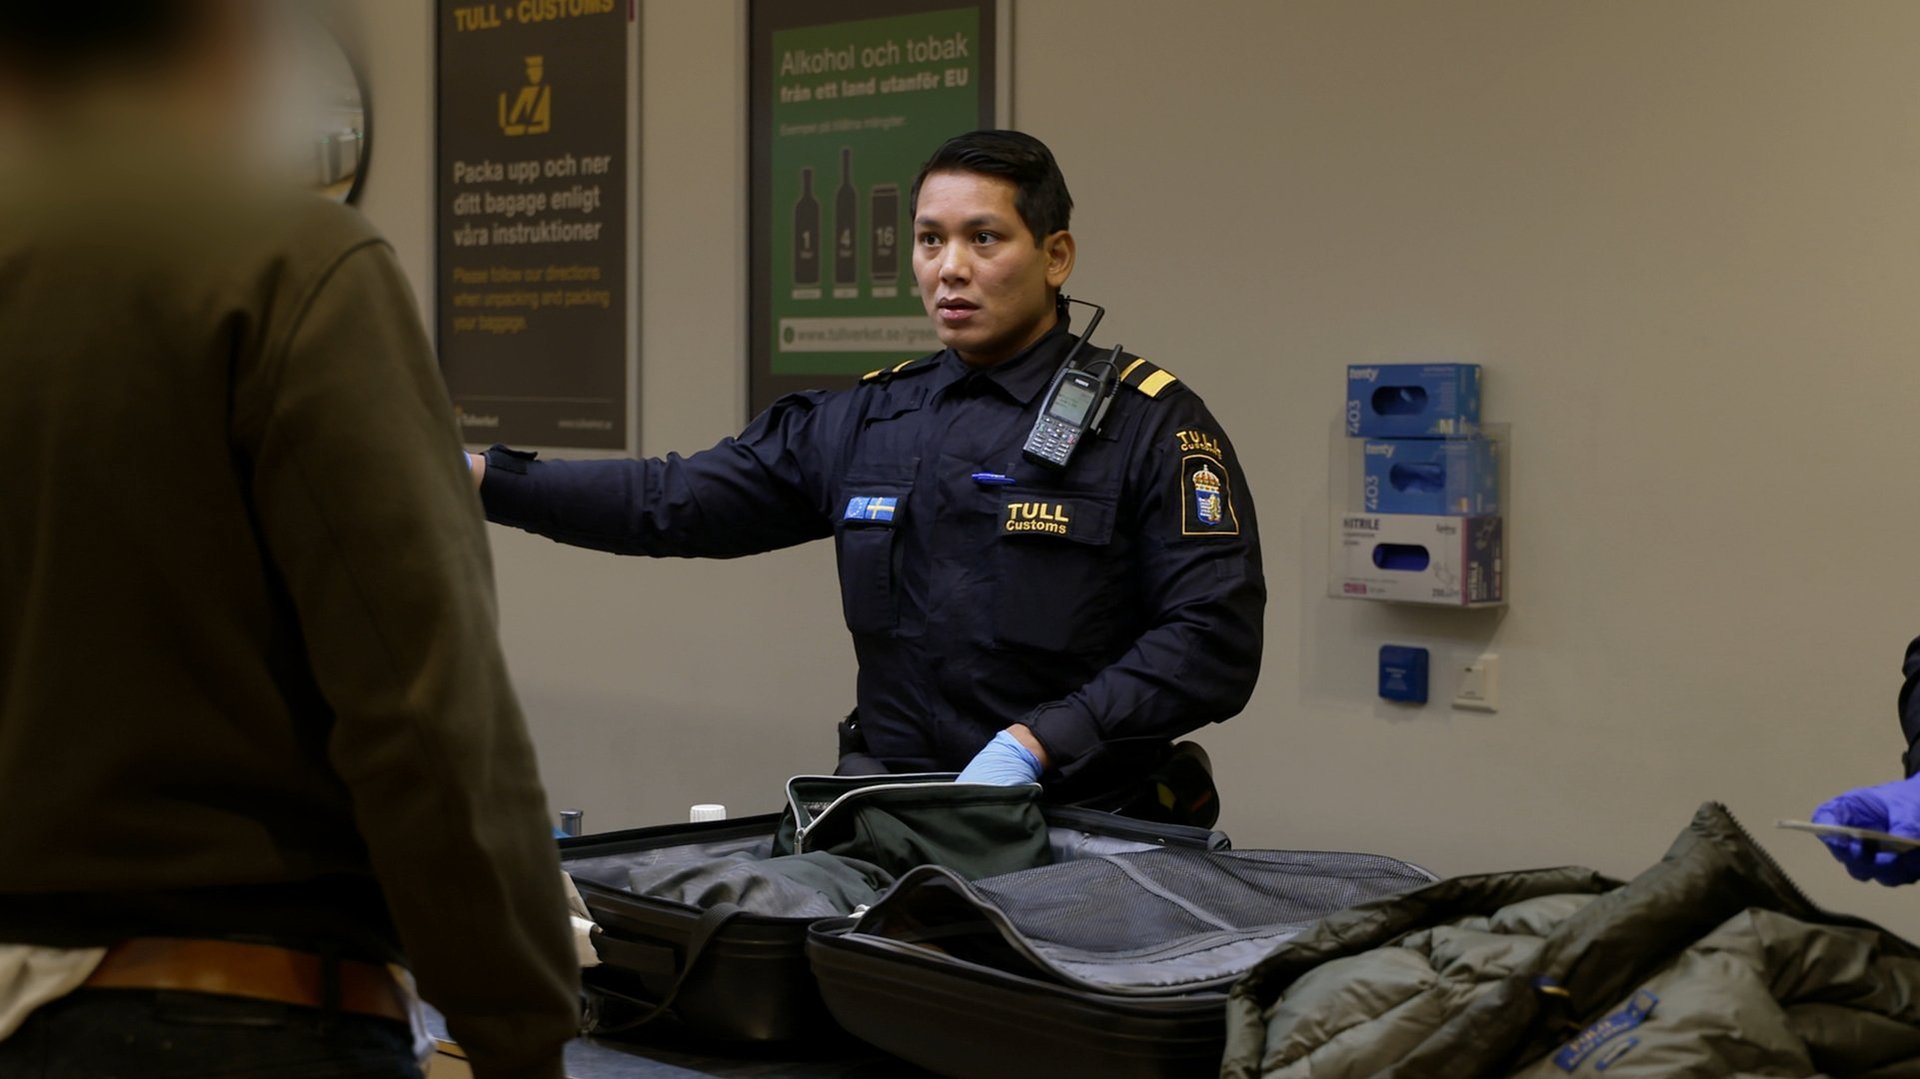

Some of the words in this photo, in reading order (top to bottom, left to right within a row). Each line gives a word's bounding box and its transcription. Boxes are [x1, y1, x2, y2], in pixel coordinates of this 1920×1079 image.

[454, 4, 501, 32] TULL
[517, 0, 614, 24] CUSTOMS
[780, 44, 855, 77] Alkohol
[861, 40, 900, 68] och
[907, 32, 969, 63] tobak
[780, 84, 812, 103] från
[815, 81, 838, 99] ett
[842, 77, 876, 97] land
[880, 71, 940, 93] utanför
[944, 68, 969, 87] EU
[454, 159, 503, 184] Packa
[508, 160, 540, 184] upp
[544, 154, 576, 178] och
[581, 155, 611, 175] ner
[454, 192, 481, 216] ditt
[484, 191, 546, 218] bagage
[551, 185, 600, 214] enligt
[453, 221, 488, 246] våra
[492, 218, 602, 245] instruktioner
[802, 229, 812, 249] 1
[840, 228, 851, 247] 4
[876, 226, 895, 247] 16
[1349, 400, 1361, 434] 403
[1176, 431, 1221, 454] TULL
[1366, 475, 1379, 510] 403
[1005, 519, 1067, 534] Customs
[1007, 502, 1070, 523] TULL
[1344, 518, 1380, 532] NITRILE
